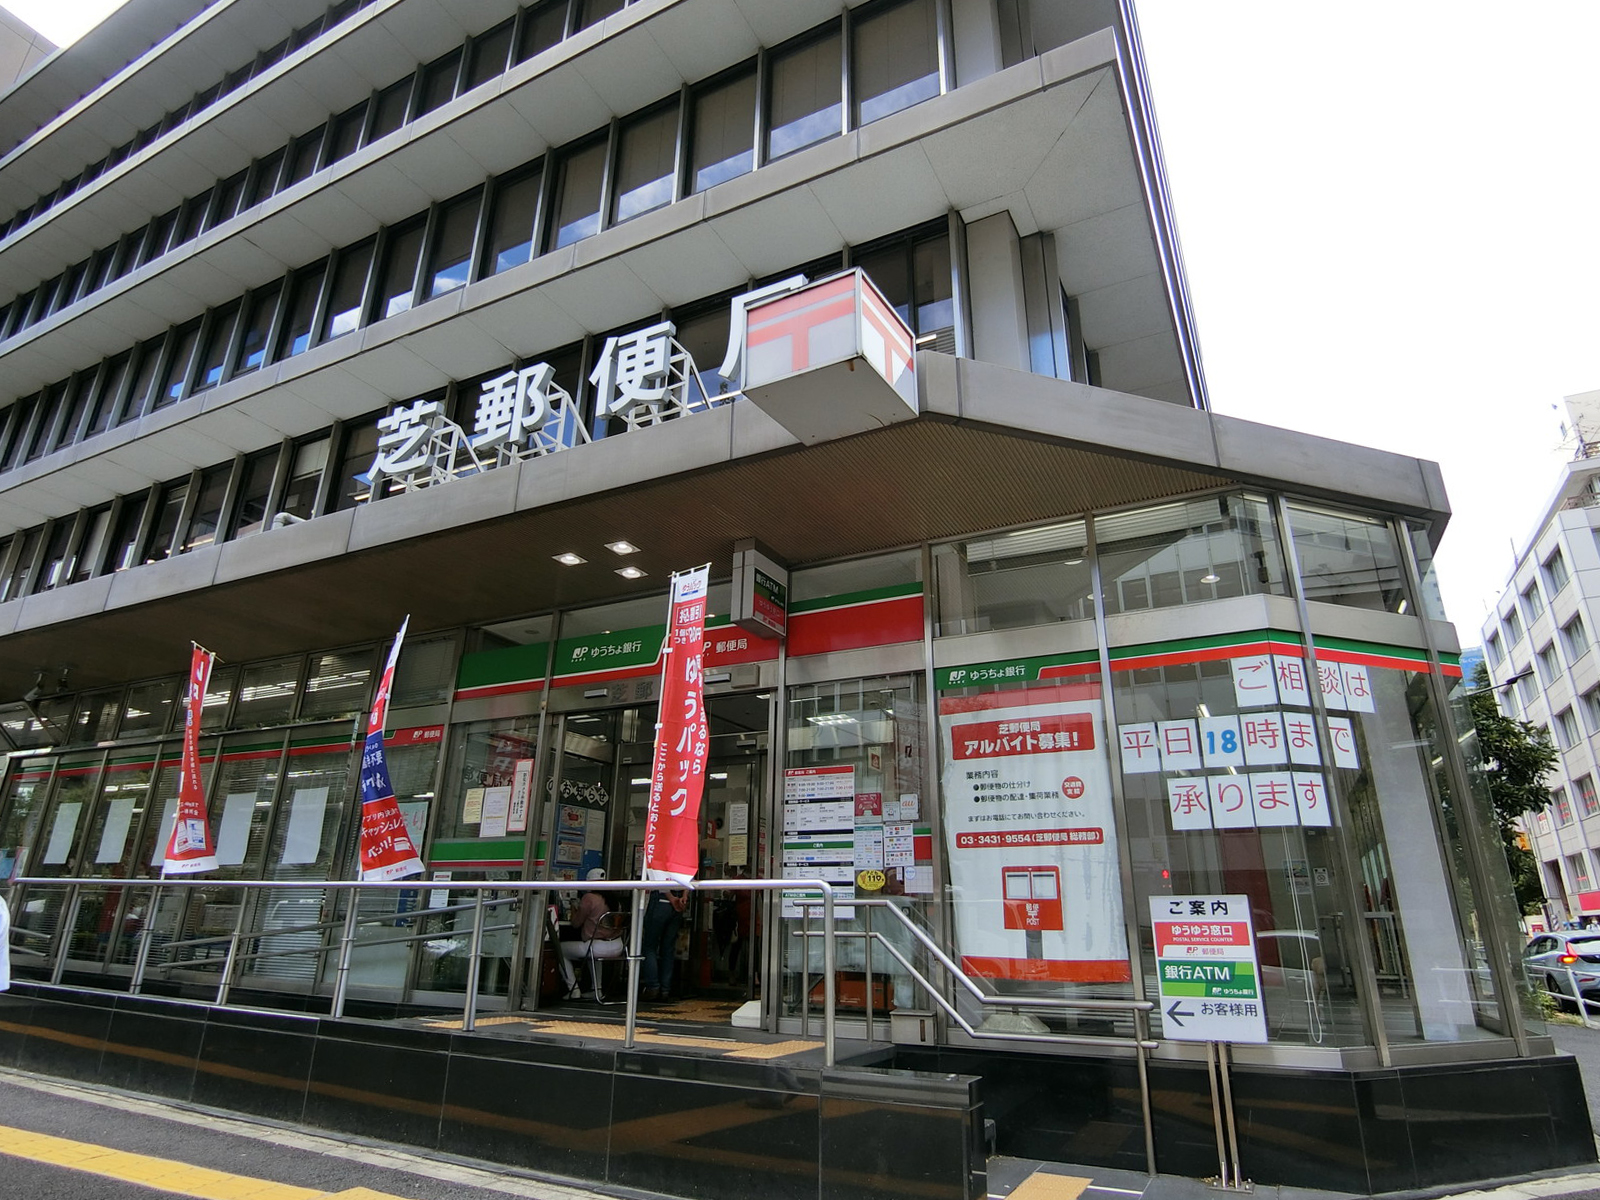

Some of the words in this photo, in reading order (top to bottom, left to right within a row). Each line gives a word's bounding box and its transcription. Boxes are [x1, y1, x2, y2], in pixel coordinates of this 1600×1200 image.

[591, 641, 642, 658] ゆうちょ銀行
[716, 638, 748, 653] 郵便局
[970, 665, 1026, 681] ゆうちょ銀行
[1238, 659, 1370, 698] ご相談は
[998, 721, 1041, 735] 芝郵便局
[1123, 718, 1350, 758] 平日18時まで
[966, 770, 999, 780] 業務内容
[648, 742, 667, 864] ここから送るとおトクです
[1172, 780, 1321, 815] 承ります
[1169, 900, 1229, 916] ご案内
[1171, 925, 1233, 936] ゆうゆう窓口
[1164, 965, 1230, 981] 銀行ATM
[1201, 1002, 1258, 1017] お客様用
